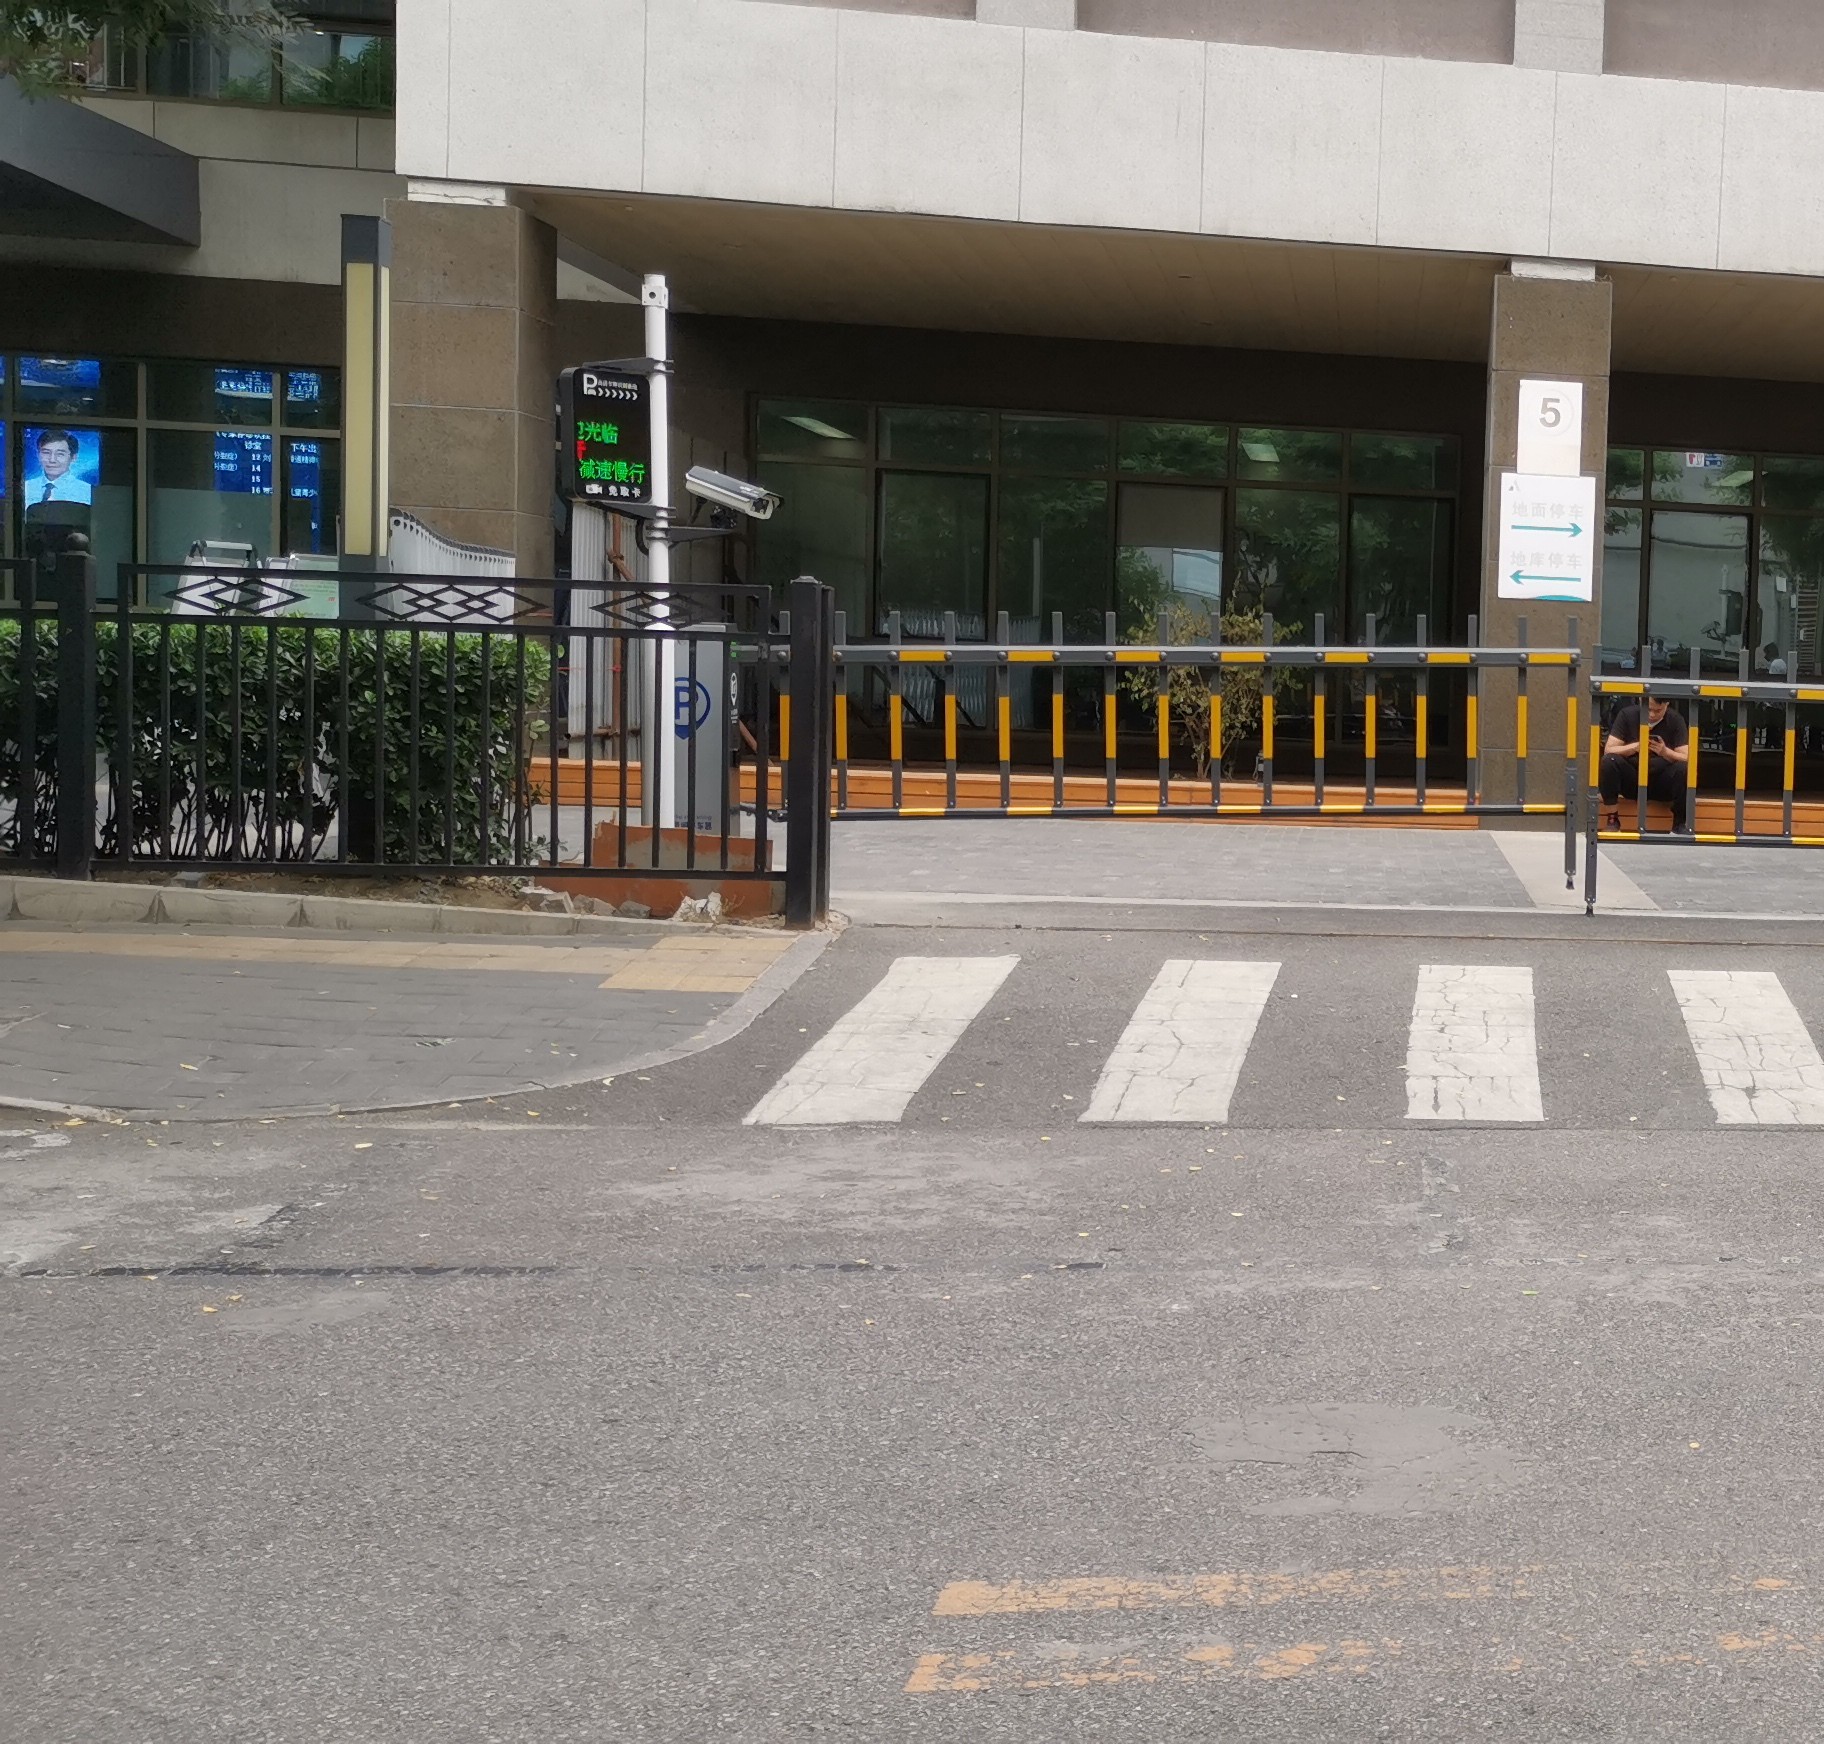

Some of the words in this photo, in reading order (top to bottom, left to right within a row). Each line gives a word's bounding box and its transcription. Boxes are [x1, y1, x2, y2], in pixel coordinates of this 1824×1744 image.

[1539, 398, 1561, 428] 5
[579, 459, 645, 484] 减速慢行
[608, 485, 641, 498] 免取卡
[1511, 501, 1584, 521] 地面停车
[1509, 550, 1583, 570] 地库停车
